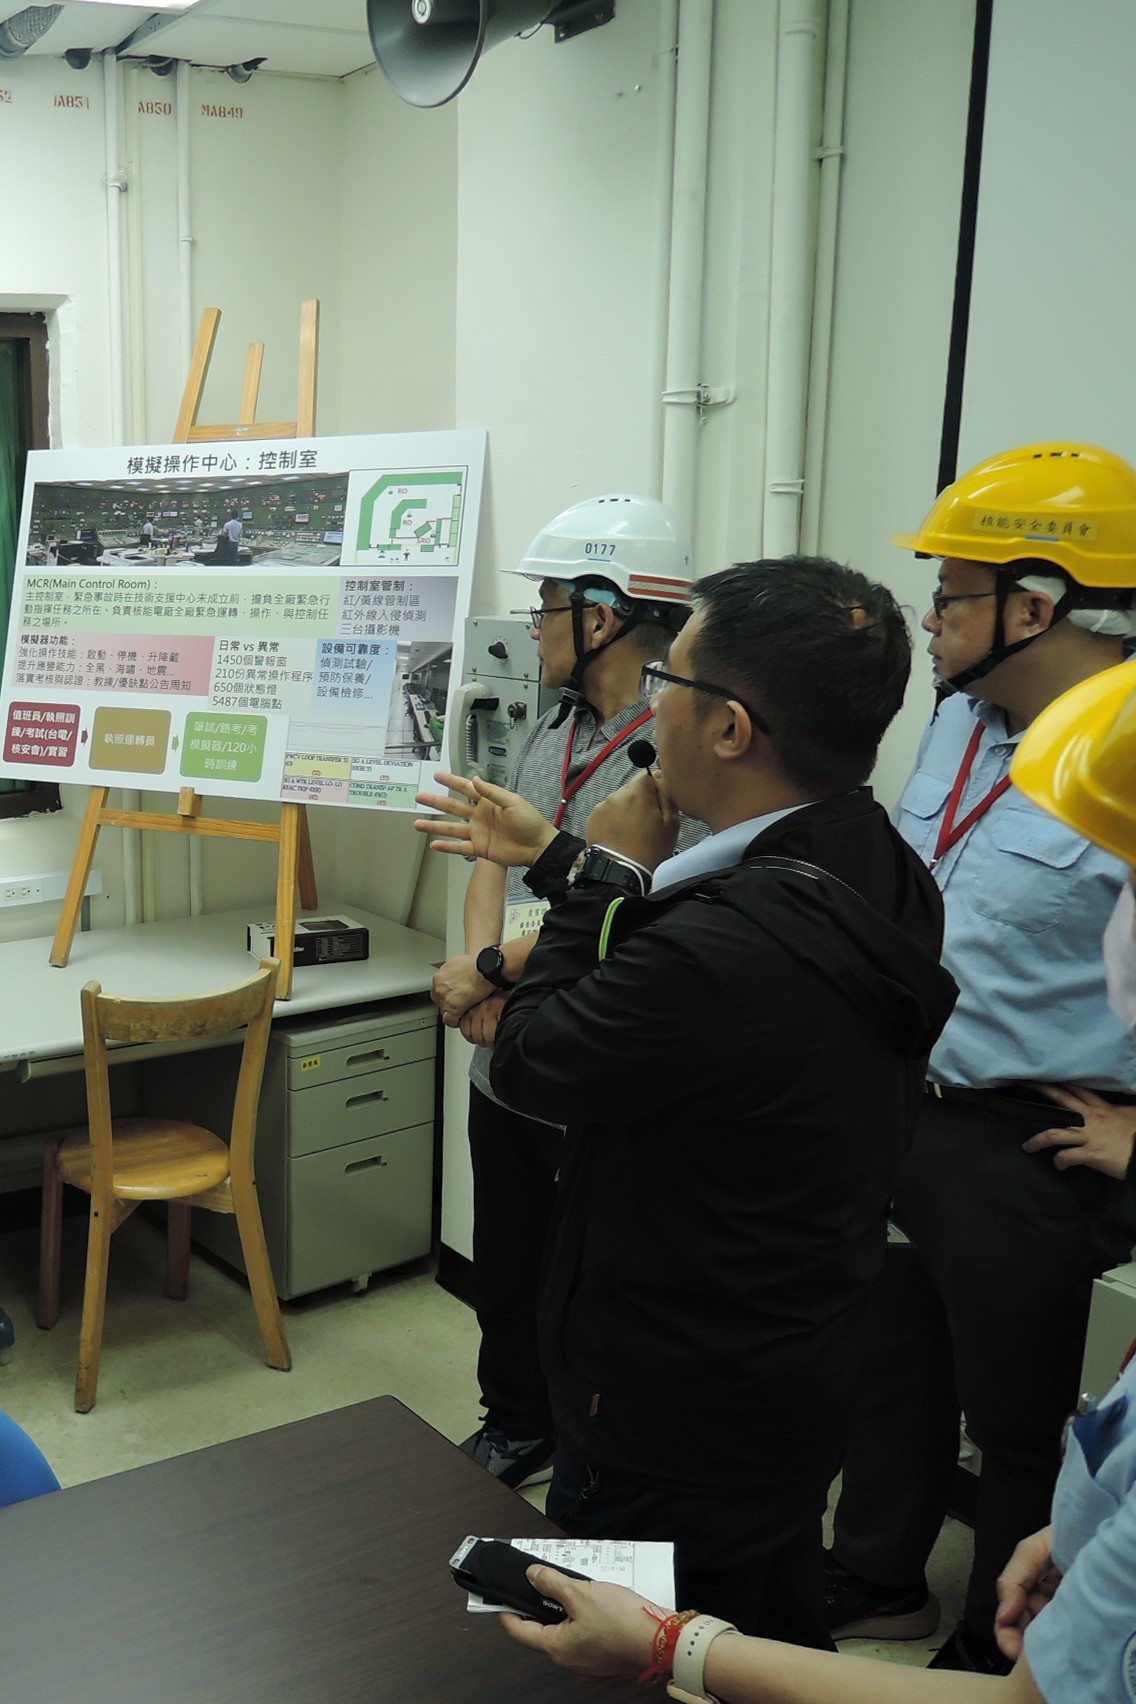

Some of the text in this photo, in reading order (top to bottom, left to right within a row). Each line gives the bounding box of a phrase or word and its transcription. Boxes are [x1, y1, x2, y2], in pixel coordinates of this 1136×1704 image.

[201, 103, 243, 118] MA849
[126, 449, 318, 475] 模擬操作中心：控制室
[980, 514, 1091, 536] 核能安全委員會
[584, 542, 616, 556] 0177
[26, 578, 77, 590] MCR(Main
[78, 578, 115, 589] Control
[344, 580, 413, 592] 控制室管制：
[342, 594, 421, 607] 紅/黃線管制區
[341, 609, 427, 622] 紅外線入侵偵測
[340, 623, 400, 636] 三台攝影機
[20, 634, 75, 646] 模擬器功能：
[218, 640, 280, 653] 日常 vs 異常
[217, 654, 288, 667] 1450個警報窗
[320, 657, 373, 670] 偵測試驗/
[215, 669, 313, 682] 210份異常操作程序
[318, 671, 372, 685] 預防保養/
[543, 1600, 563, 1612] SONY
